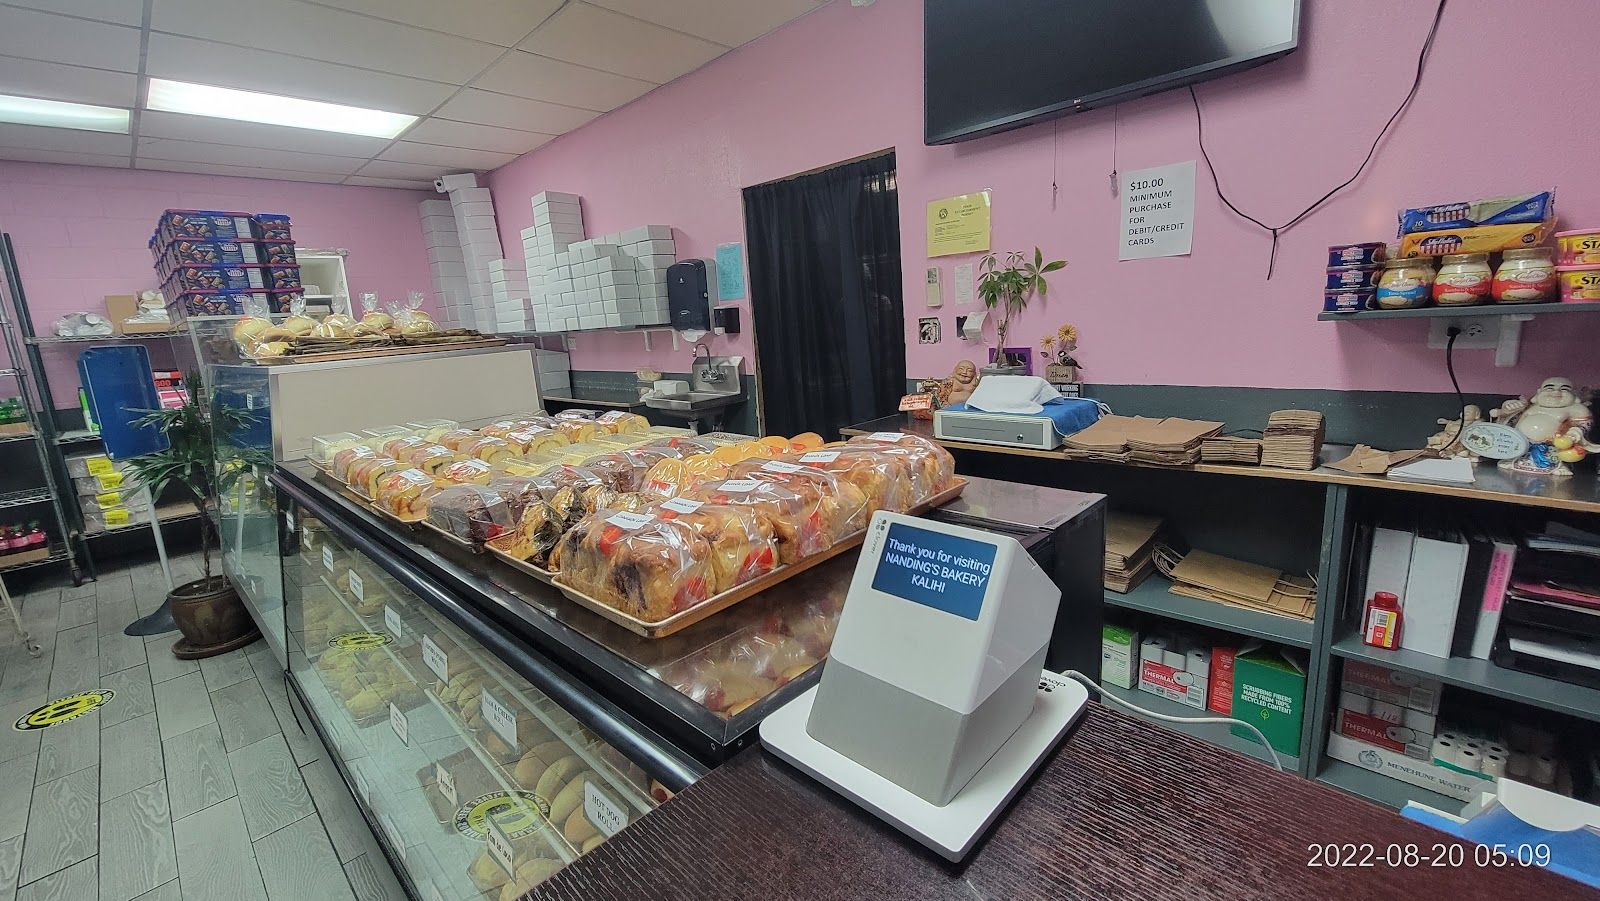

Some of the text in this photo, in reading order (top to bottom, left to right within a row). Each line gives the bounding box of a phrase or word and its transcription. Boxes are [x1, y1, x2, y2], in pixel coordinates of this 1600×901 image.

[1130, 178, 1164, 192] $10.00
[1130, 190, 1172, 202] MINIMUM
[1129, 202, 1172, 214] PURCHASE
[1128, 222, 1184, 236] DEBIT/CREDIT
[1129, 217, 1145, 225] FOR
[1128, 237, 1155, 247] CARDS
[888, 538, 991, 576] Thank you for visiting
[885, 551, 986, 588] NANDING'S BAKERY
[911, 573, 946, 594] KALIHI
[1144, 669, 1175, 684] THERMAL
[1242, 683, 1293, 704] SCRUBBING FIBERS
[1243, 689, 1291, 709] MADE FROM 100%
[1241, 694, 1292, 715] RECYCLED CONTENT
[1344, 721, 1389, 740] THERMAL
[1387, 761, 1472, 793] MENEHUNE WATER
[592, 794, 620, 826] HOT DOG
[597, 811, 615, 833] ROLL
